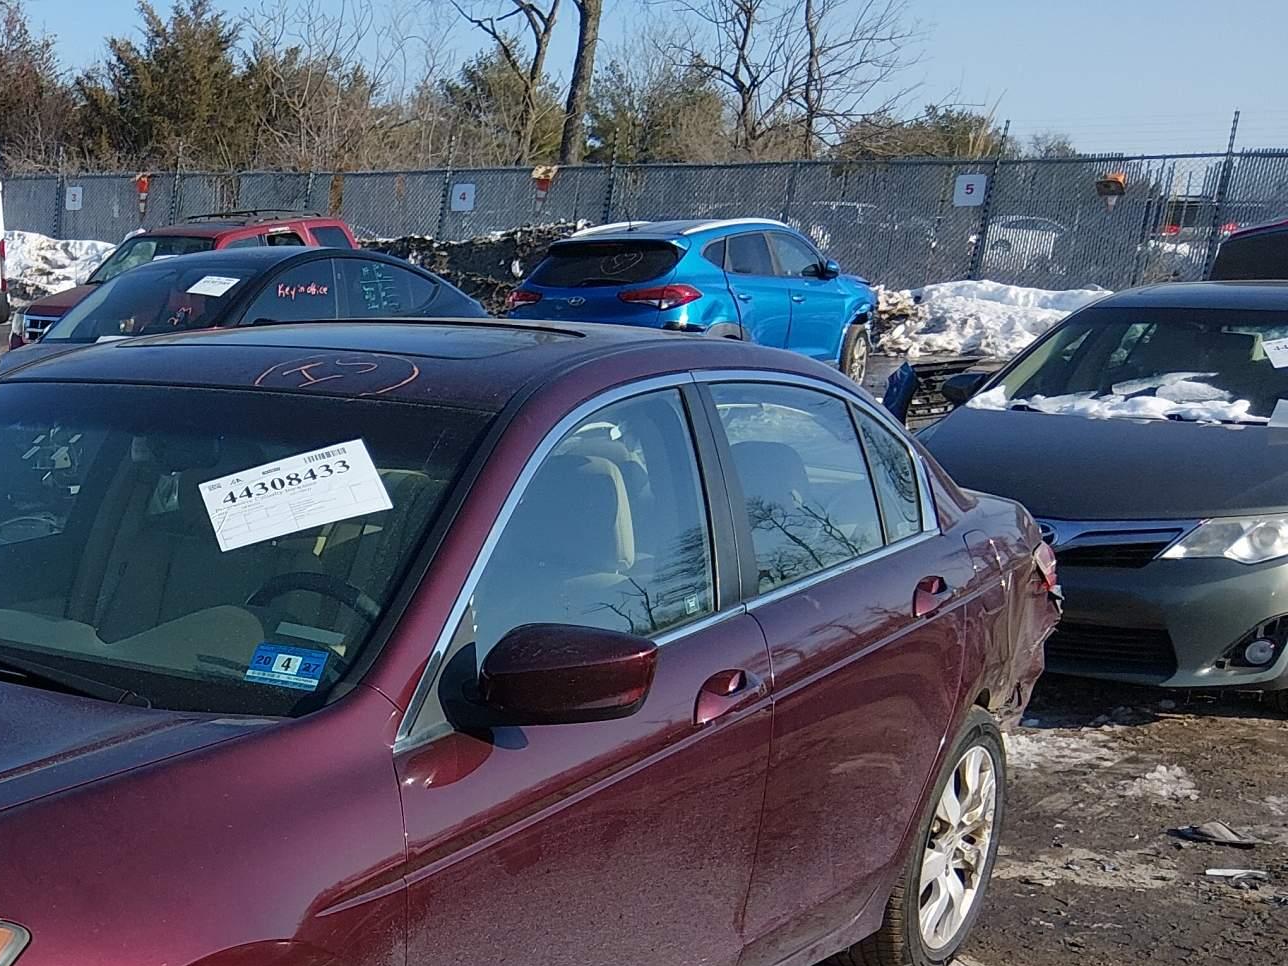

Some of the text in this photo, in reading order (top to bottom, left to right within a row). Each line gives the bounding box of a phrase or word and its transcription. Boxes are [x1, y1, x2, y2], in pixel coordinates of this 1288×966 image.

[965, 183, 975, 195] 5
[459, 192, 467, 201] 4
[278, 283, 296, 300] Key
[306, 281, 328, 295] office
[223, 460, 350, 503] 44308433
[281, 657, 293, 671] 4
